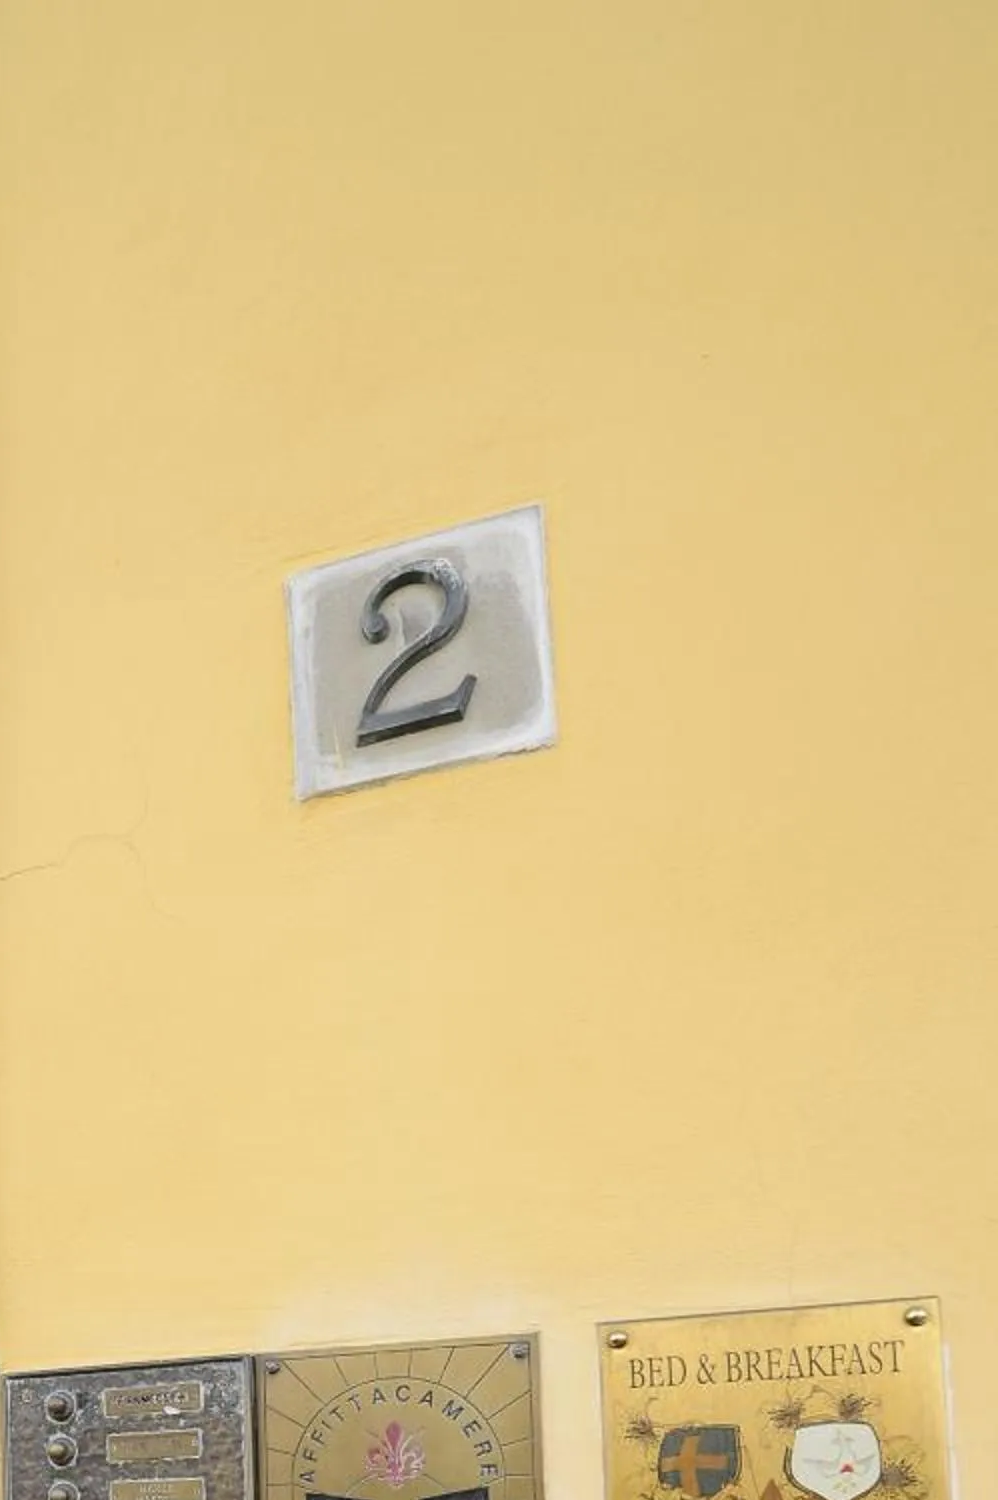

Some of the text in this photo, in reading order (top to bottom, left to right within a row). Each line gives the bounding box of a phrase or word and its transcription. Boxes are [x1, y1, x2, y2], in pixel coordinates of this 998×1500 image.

[356, 557, 477, 748] 2
[628, 1340, 905, 1389] BED & BREAKFAST
[300, 1384, 501, 1484] AFFITTACAMERE
